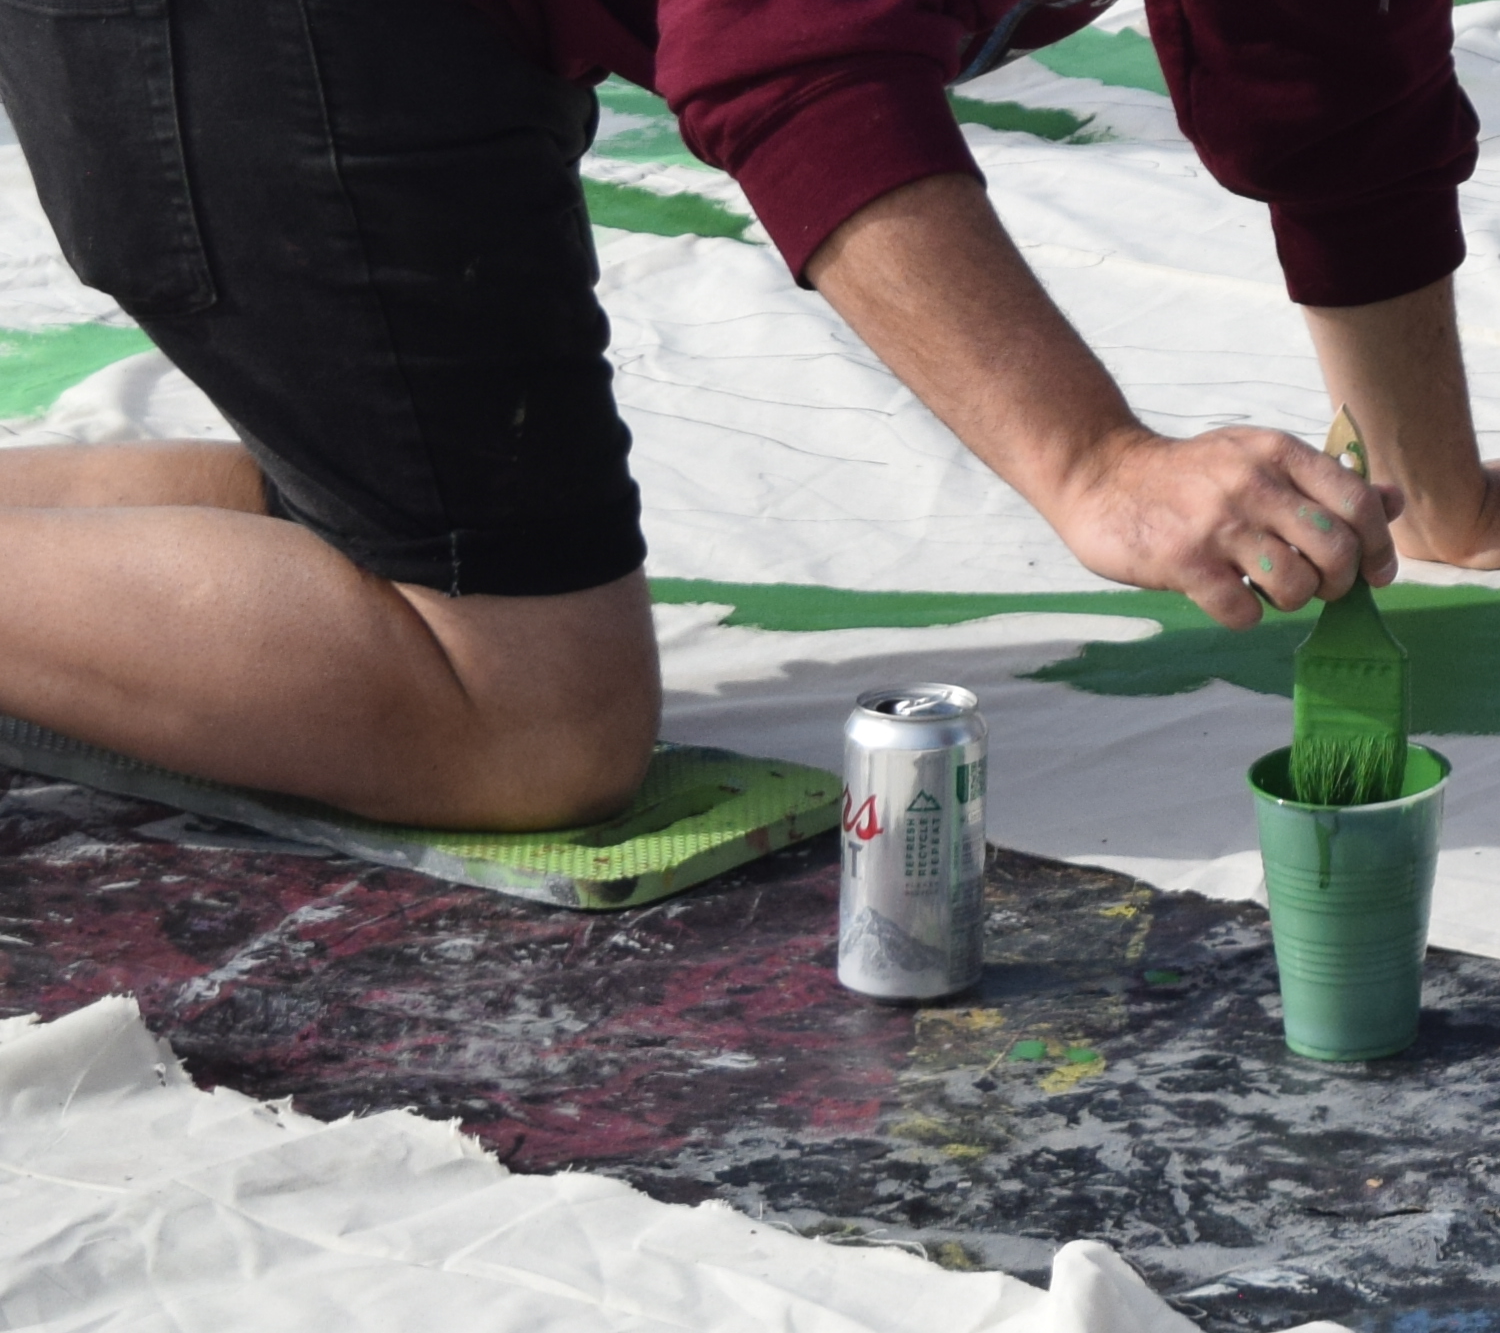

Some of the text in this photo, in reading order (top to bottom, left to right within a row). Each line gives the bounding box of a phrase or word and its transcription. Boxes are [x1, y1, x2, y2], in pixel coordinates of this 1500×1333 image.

[905, 817, 917, 877] REFRESH
[917, 817, 929, 877] RECYCLE
[930, 817, 942, 876] REPEAT
